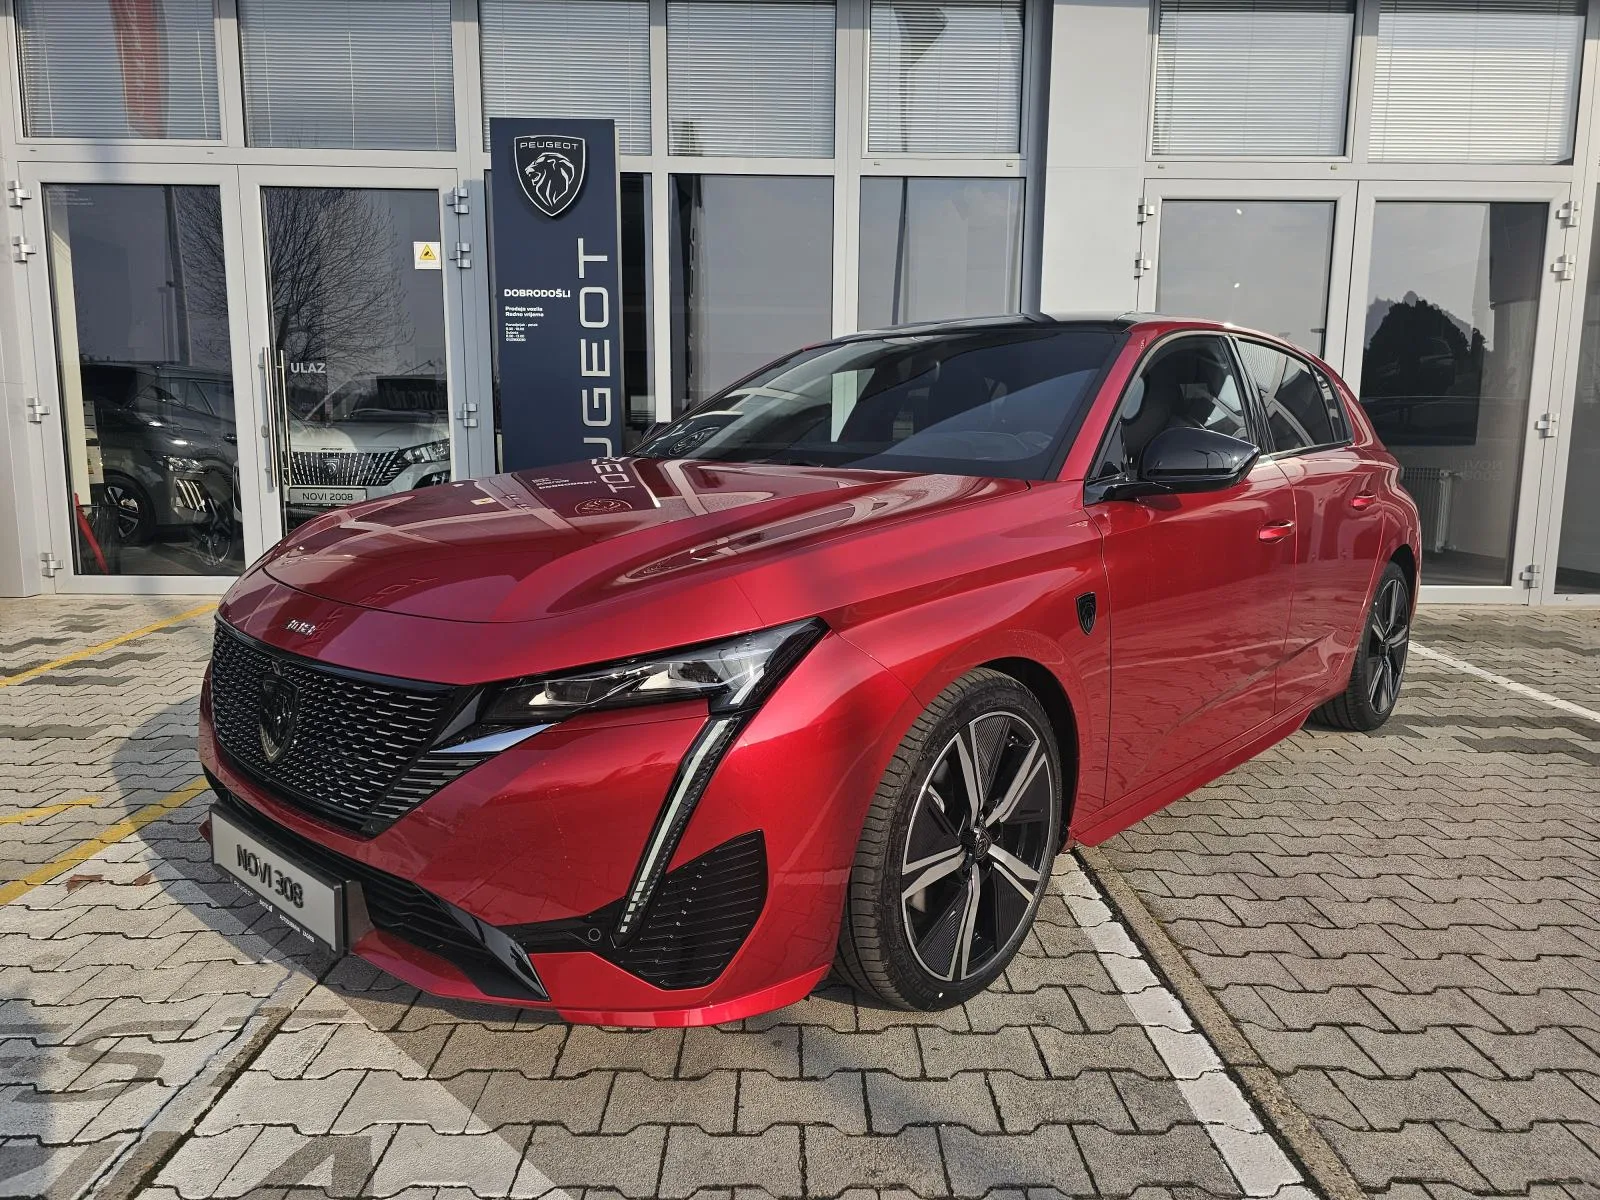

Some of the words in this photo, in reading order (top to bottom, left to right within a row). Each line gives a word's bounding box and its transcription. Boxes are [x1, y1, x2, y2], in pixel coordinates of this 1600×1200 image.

[519, 141, 579, 150] PEUGEOT
[503, 288, 571, 298] DOBRODOŠLI
[290, 362, 326, 374] ULAZ
[302, 492, 327, 501] NOVI
[329, 492, 354, 501] 2008
[236, 843, 272, 889] NOVI
[273, 869, 304, 909] 308
